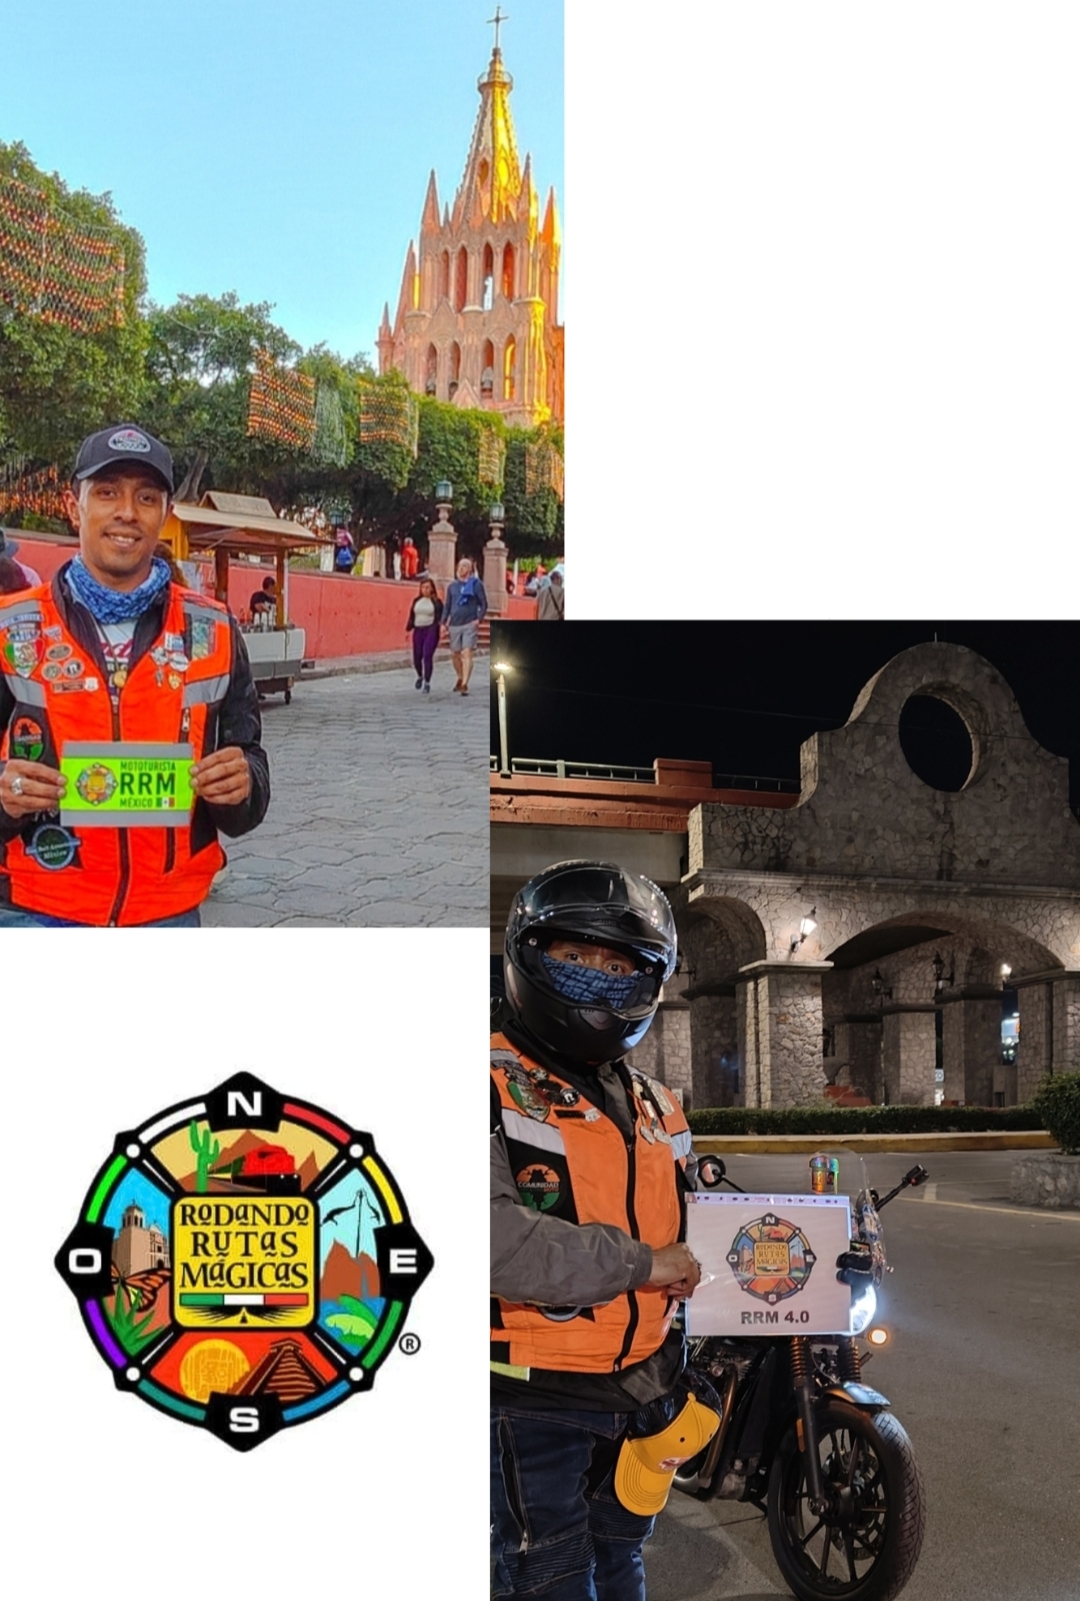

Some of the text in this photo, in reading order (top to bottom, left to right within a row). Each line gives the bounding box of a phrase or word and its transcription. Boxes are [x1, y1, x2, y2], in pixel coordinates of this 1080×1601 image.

[120, 761, 176, 772] MOTOTURISTA
[120, 772, 175, 795] RRM
[120, 797, 153, 808] MÉXICO
[227, 1091, 262, 1117] N
[765, 1216, 775, 1224] N
[68, 1248, 102, 1274] O
[389, 1248, 417, 1274] E
[741, 1311, 779, 1324] RRM
[784, 1310, 810, 1324] 4.0
[229, 1407, 260, 1433] S
